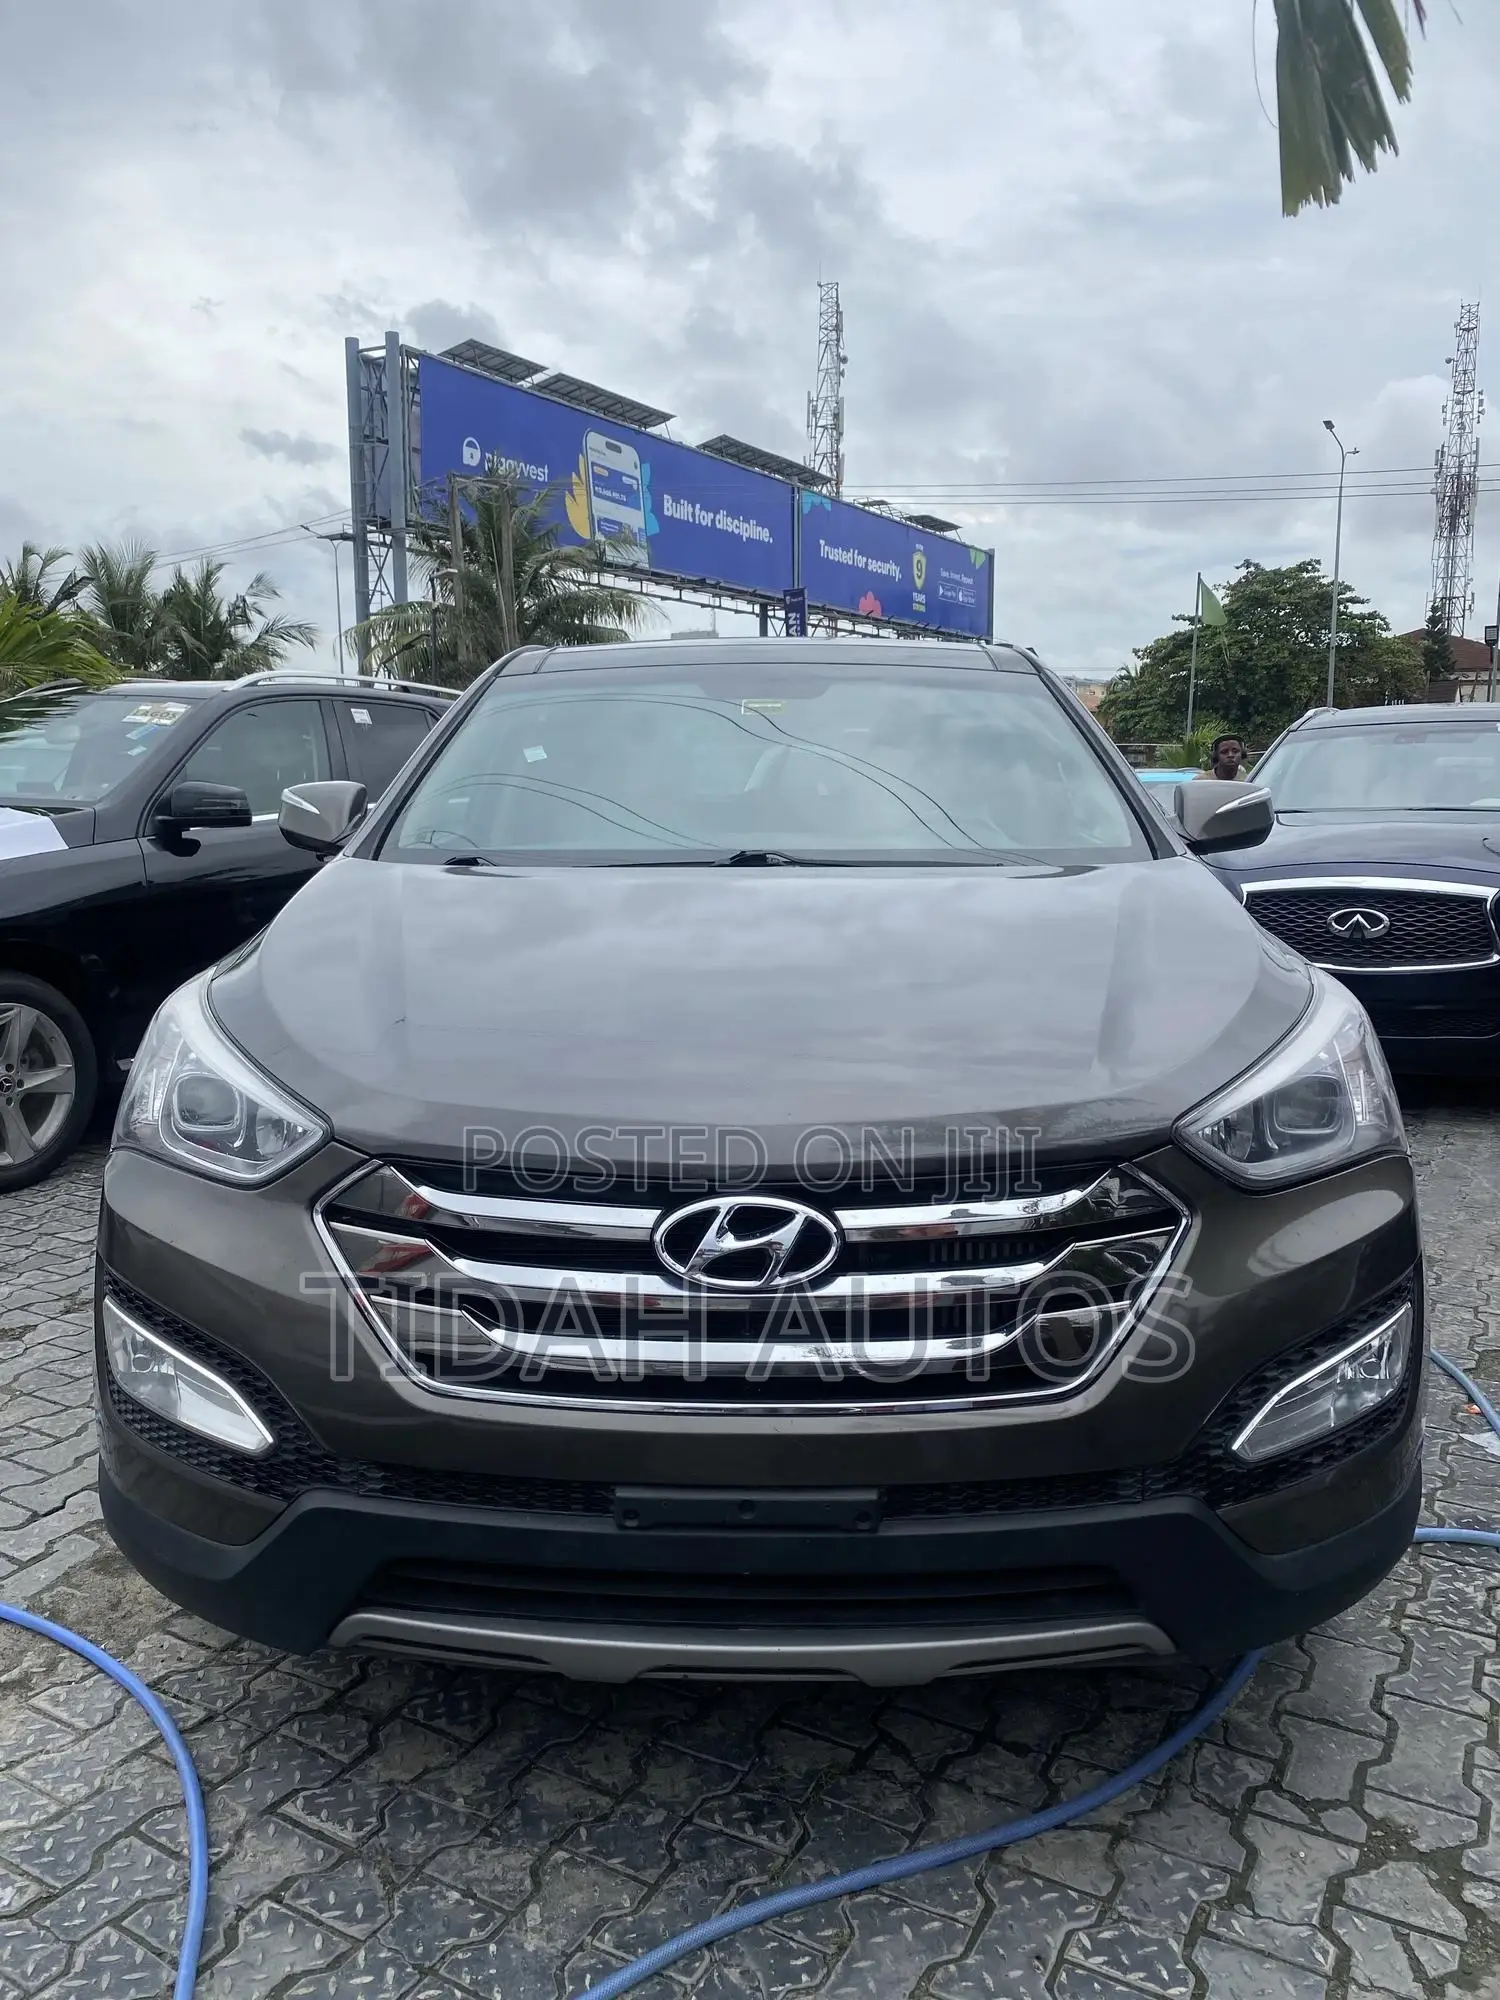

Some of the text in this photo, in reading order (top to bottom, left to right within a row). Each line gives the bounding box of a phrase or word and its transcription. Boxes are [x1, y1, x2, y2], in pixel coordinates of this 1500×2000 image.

[663, 494, 774, 544] Built for discipline.
[819, 539, 902, 582] Trusted for security.
[915, 559, 923, 580] 9
